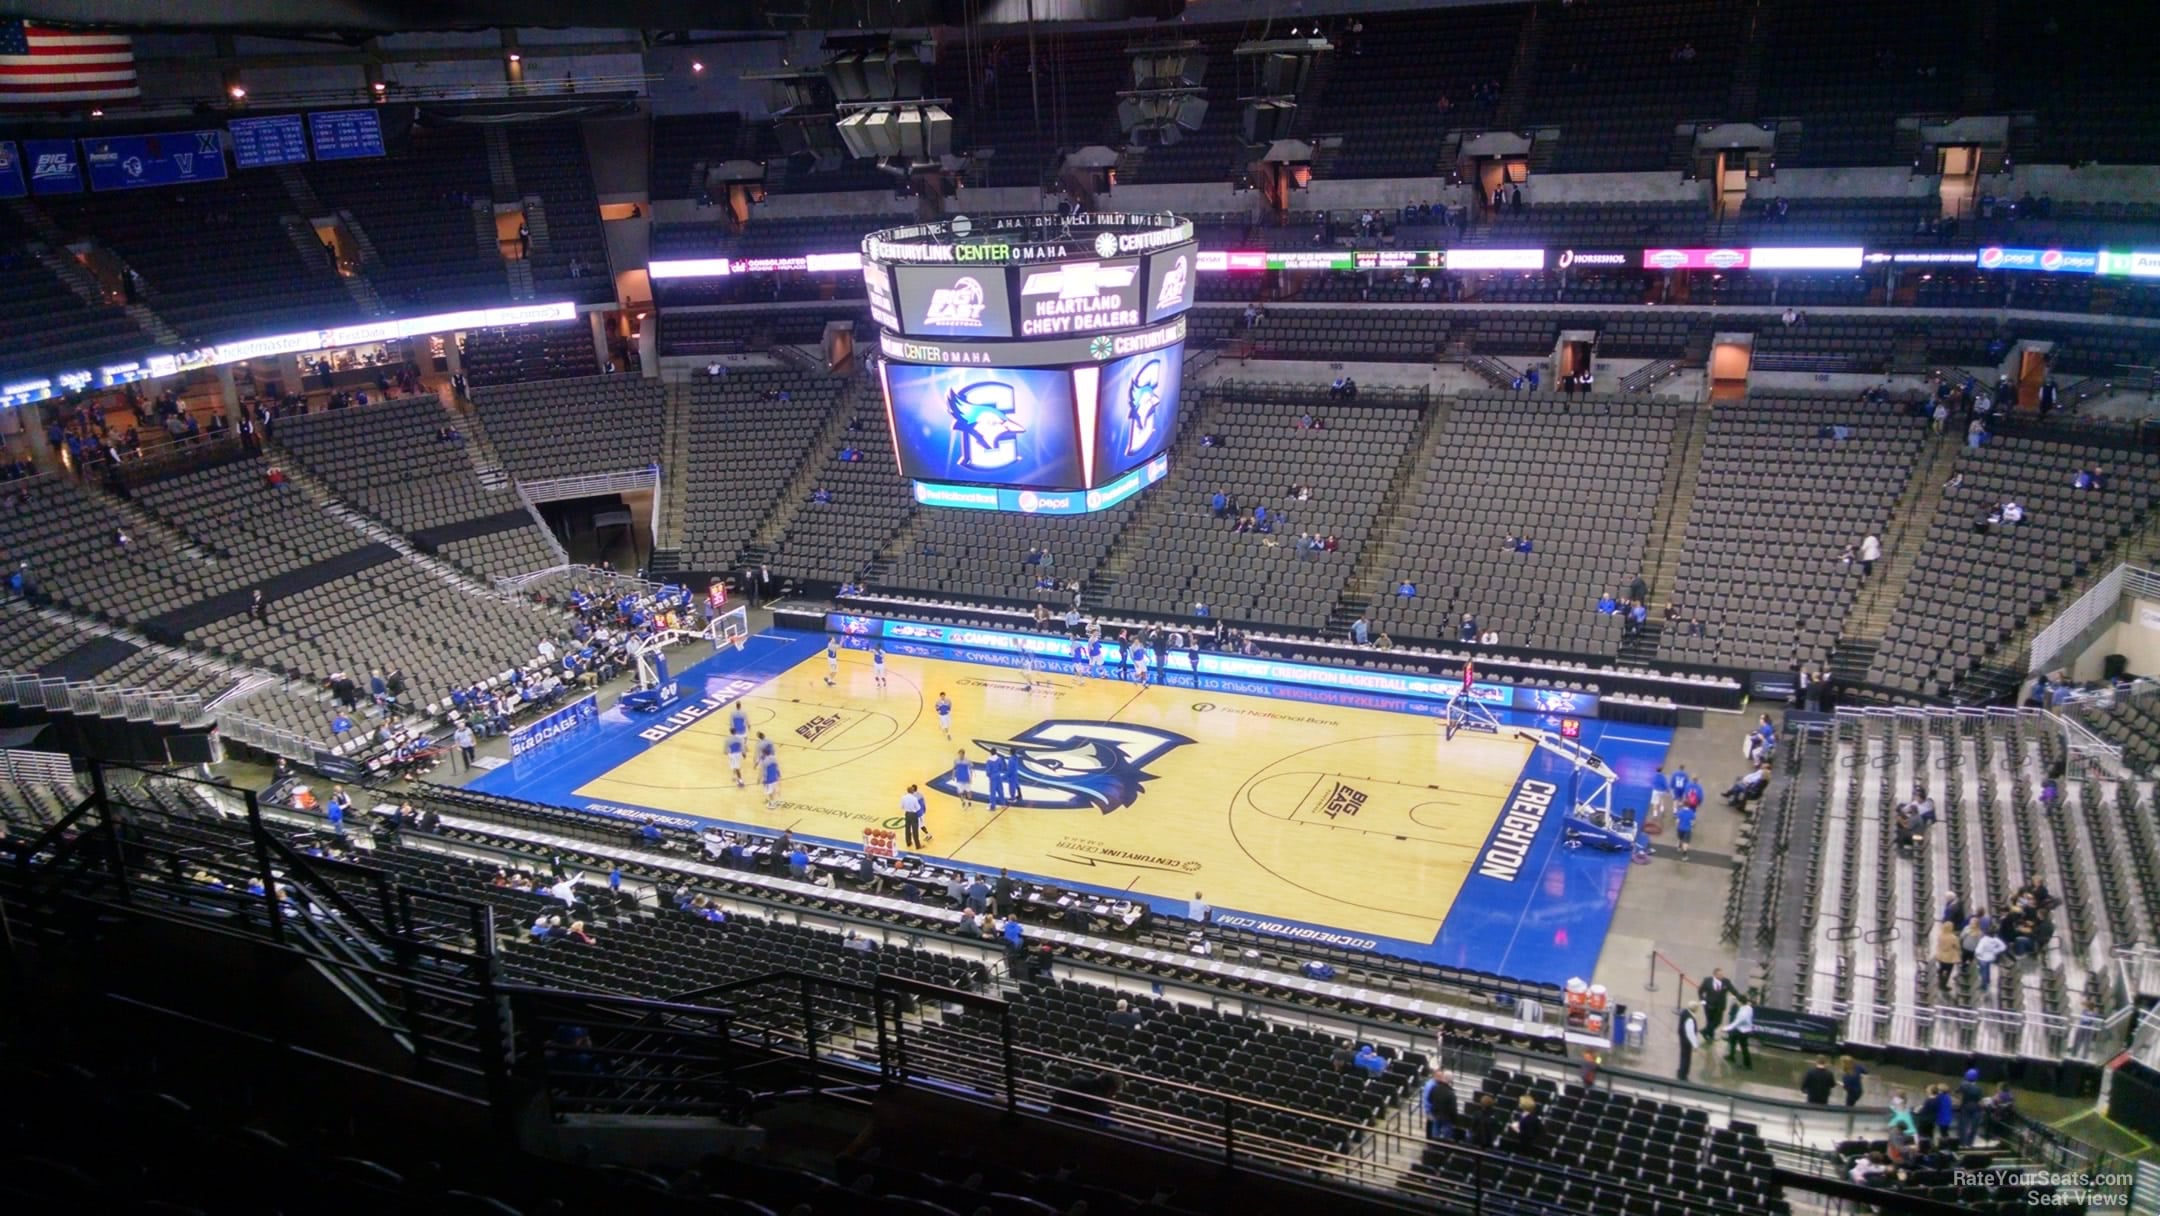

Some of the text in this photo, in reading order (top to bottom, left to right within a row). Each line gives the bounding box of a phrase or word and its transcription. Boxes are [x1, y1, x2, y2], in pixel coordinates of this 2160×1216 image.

[35, 162, 76, 175] EAST
[38, 153, 67, 164] BIG
[878, 243, 1067, 261] CENTURYLINK CENTER OMAHA
[2003, 254, 2034, 265] pepsi
[2064, 256, 2094, 268] pepsi
[927, 303, 985, 318] EAST
[1036, 294, 1122, 316] HEARTLAND
[1023, 310, 1138, 335] CHEVY DEALERS
[223, 337, 301, 359] ticketmaster
[904, 343, 940, 360] CENTER
[942, 351, 991, 363] OMAHA
[1039, 497, 1069, 510] pepsi
[964, 632, 1008, 648] CAMPING
[1220, 661, 1269, 676] SUPPORT
[1272, 666, 1337, 684] CREIGHTON
[1339, 673, 1408, 690] BASKETBALL
[639, 680, 755, 742] BLUEJAYS
[1248, 710, 1304, 722] National
[1306, 717, 1339, 727] Bank
[512, 714, 577, 756] BIRDCAGE
[795, 715, 825, 735] BIG
[802, 713, 841, 740] EAST
[796, 803, 851, 819] National
[1324, 785, 1354, 820] EAST
[1342, 790, 1368, 816] BIG
[853, 813, 880, 823] First
[1478, 778, 1557, 882] CREIGHTON
[1056, 841, 1181, 867] CENTURYLINK CENTER
[1217, 914, 1377, 949] GOCREIGHTON.COM
